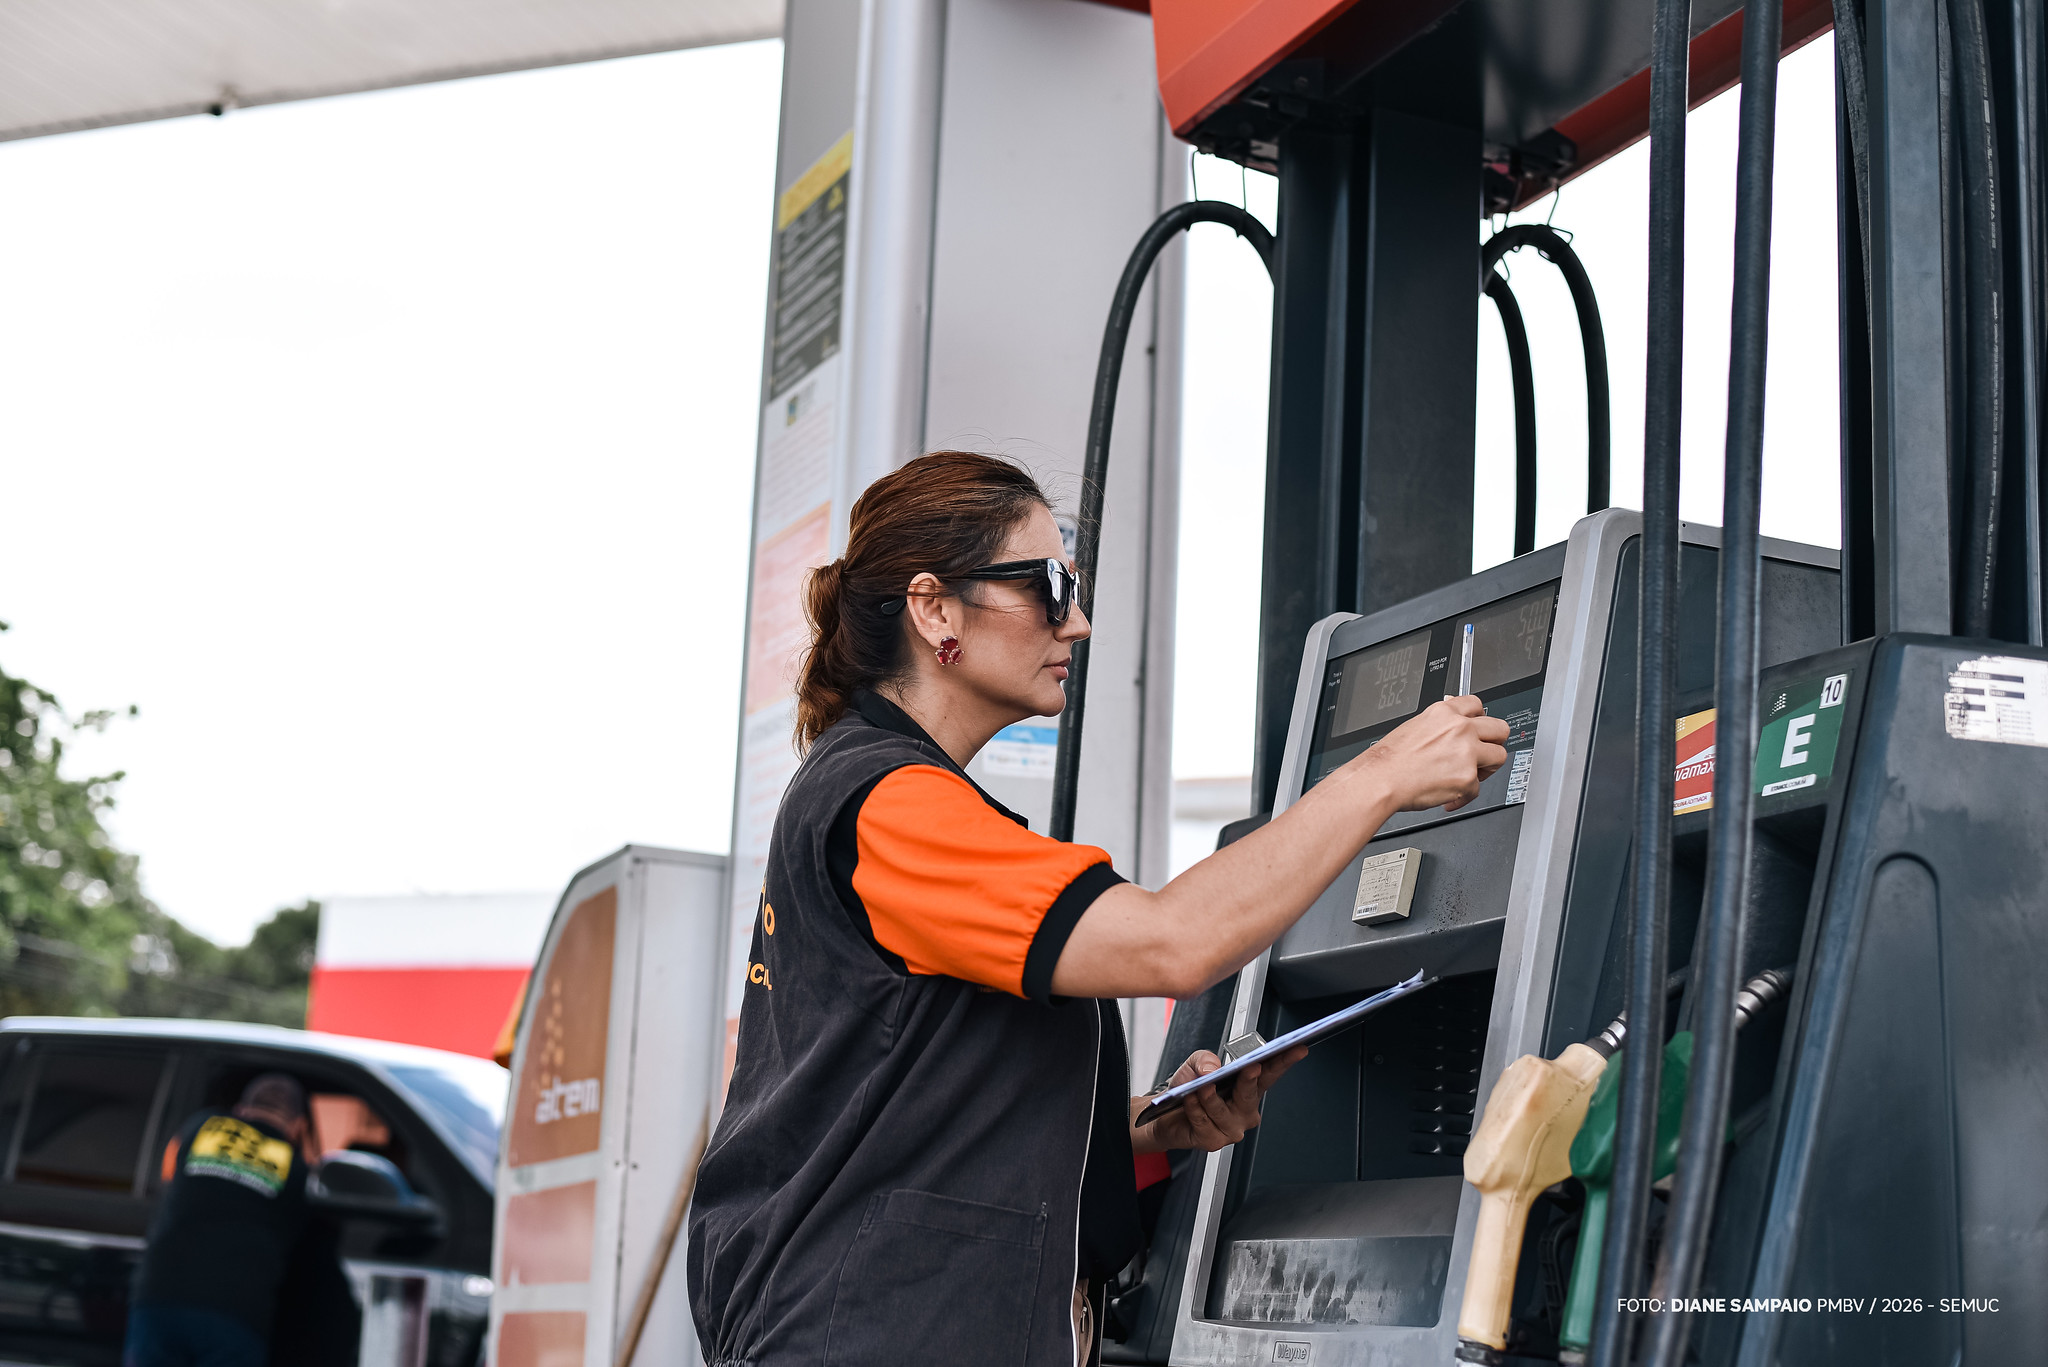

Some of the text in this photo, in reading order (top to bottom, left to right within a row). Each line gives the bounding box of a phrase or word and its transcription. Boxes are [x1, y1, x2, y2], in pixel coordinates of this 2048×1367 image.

[1825, 680, 1842, 703] 10
[1780, 713, 1816, 768] E
[1277, 1344, 1308, 1362] Wayne
